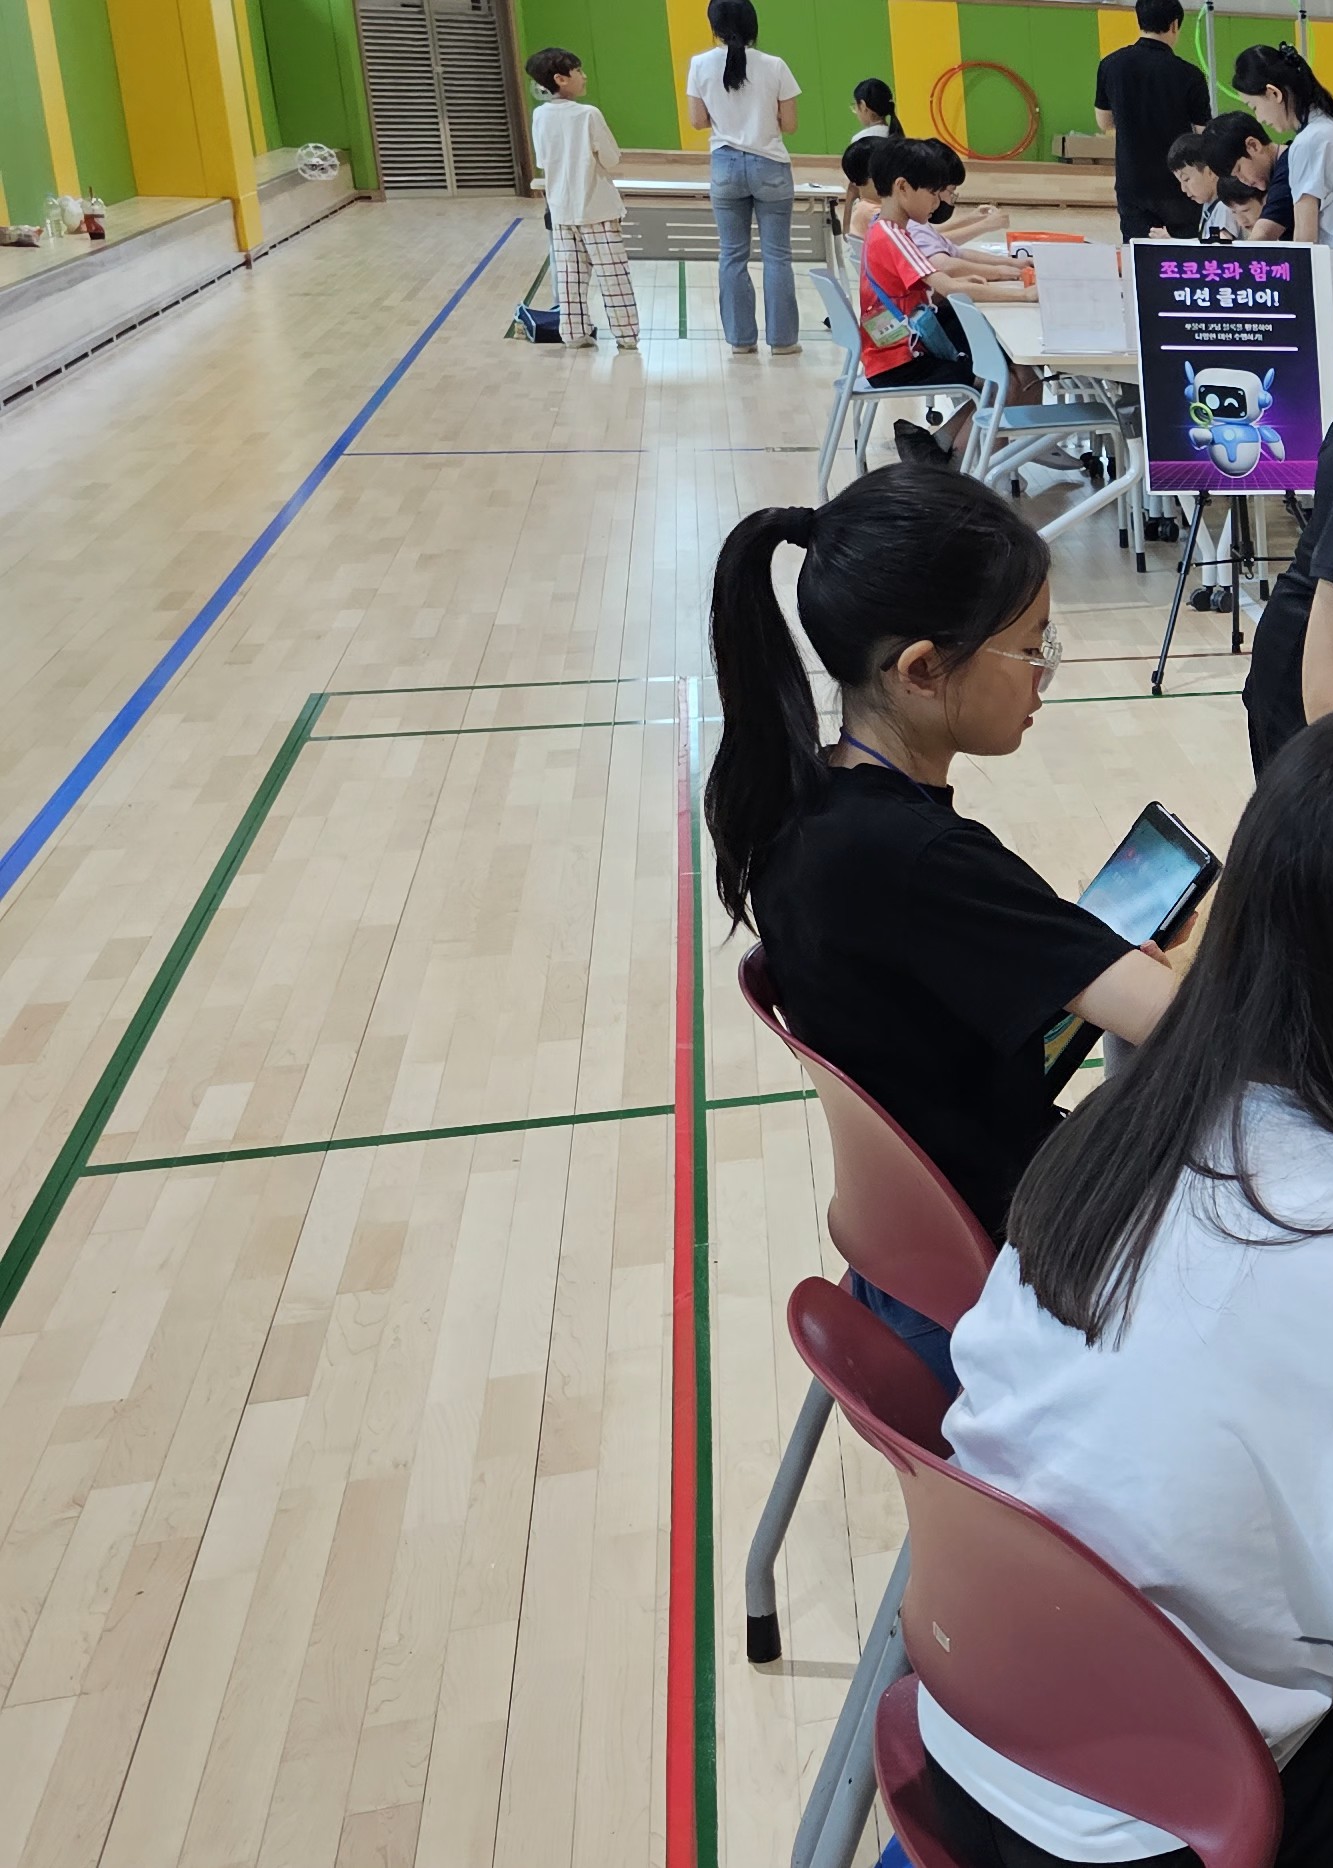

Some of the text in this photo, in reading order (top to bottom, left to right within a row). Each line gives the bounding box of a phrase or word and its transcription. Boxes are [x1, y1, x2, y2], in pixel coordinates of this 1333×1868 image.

[1159, 261, 1291, 282] 쪼코봇과 함께
[1173, 287, 1280, 307] 미션 클리어!
